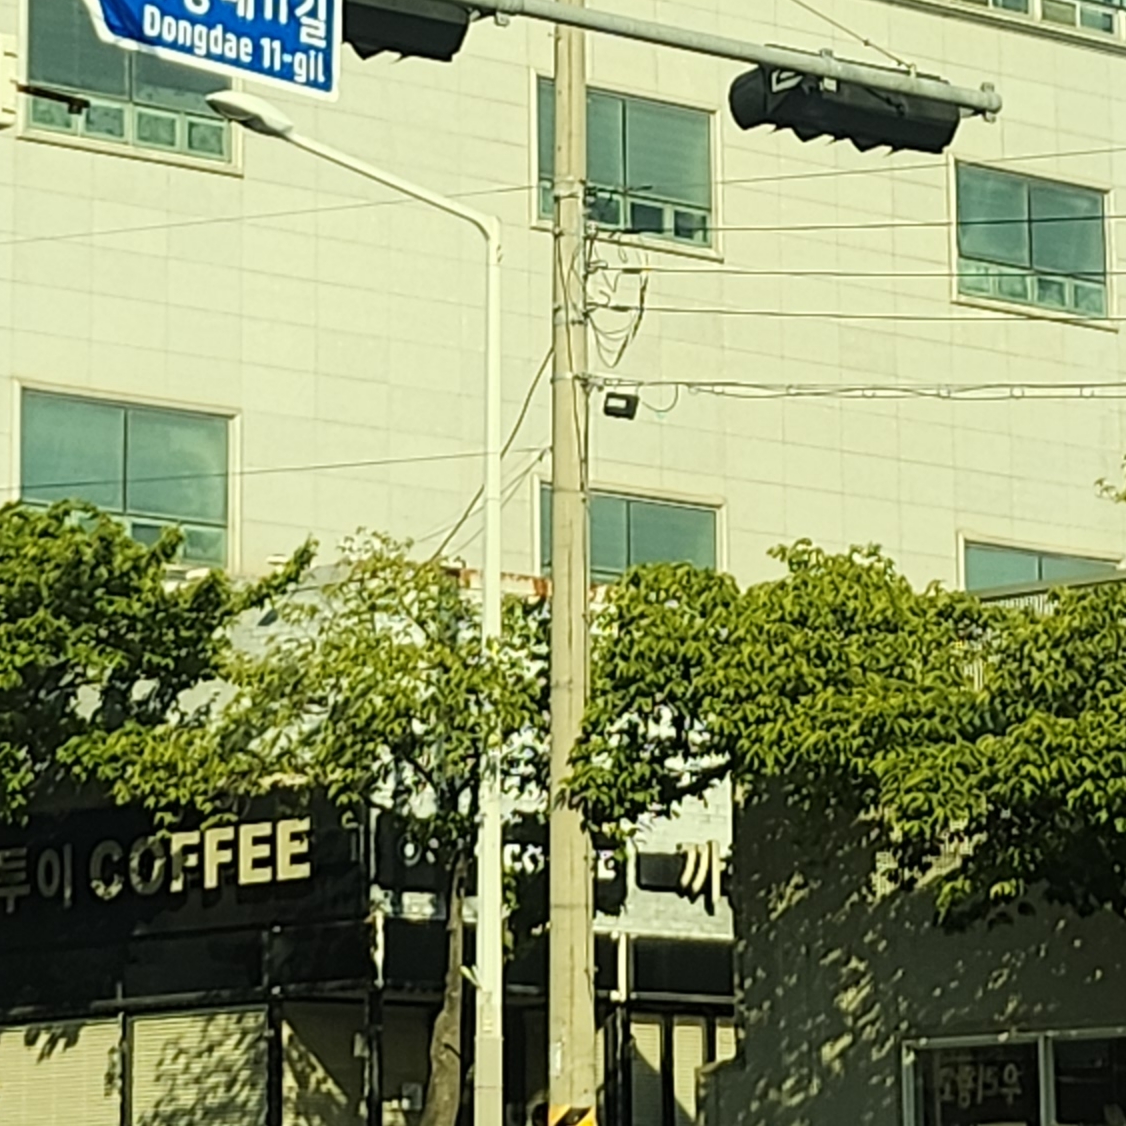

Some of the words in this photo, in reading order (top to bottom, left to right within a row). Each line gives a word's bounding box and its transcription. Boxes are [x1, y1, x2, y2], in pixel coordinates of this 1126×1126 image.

[143, 3, 254, 63] Dongdae
[260, 37, 326, 83] 11-gil
[88, 816, 311, 901] COFFEE
